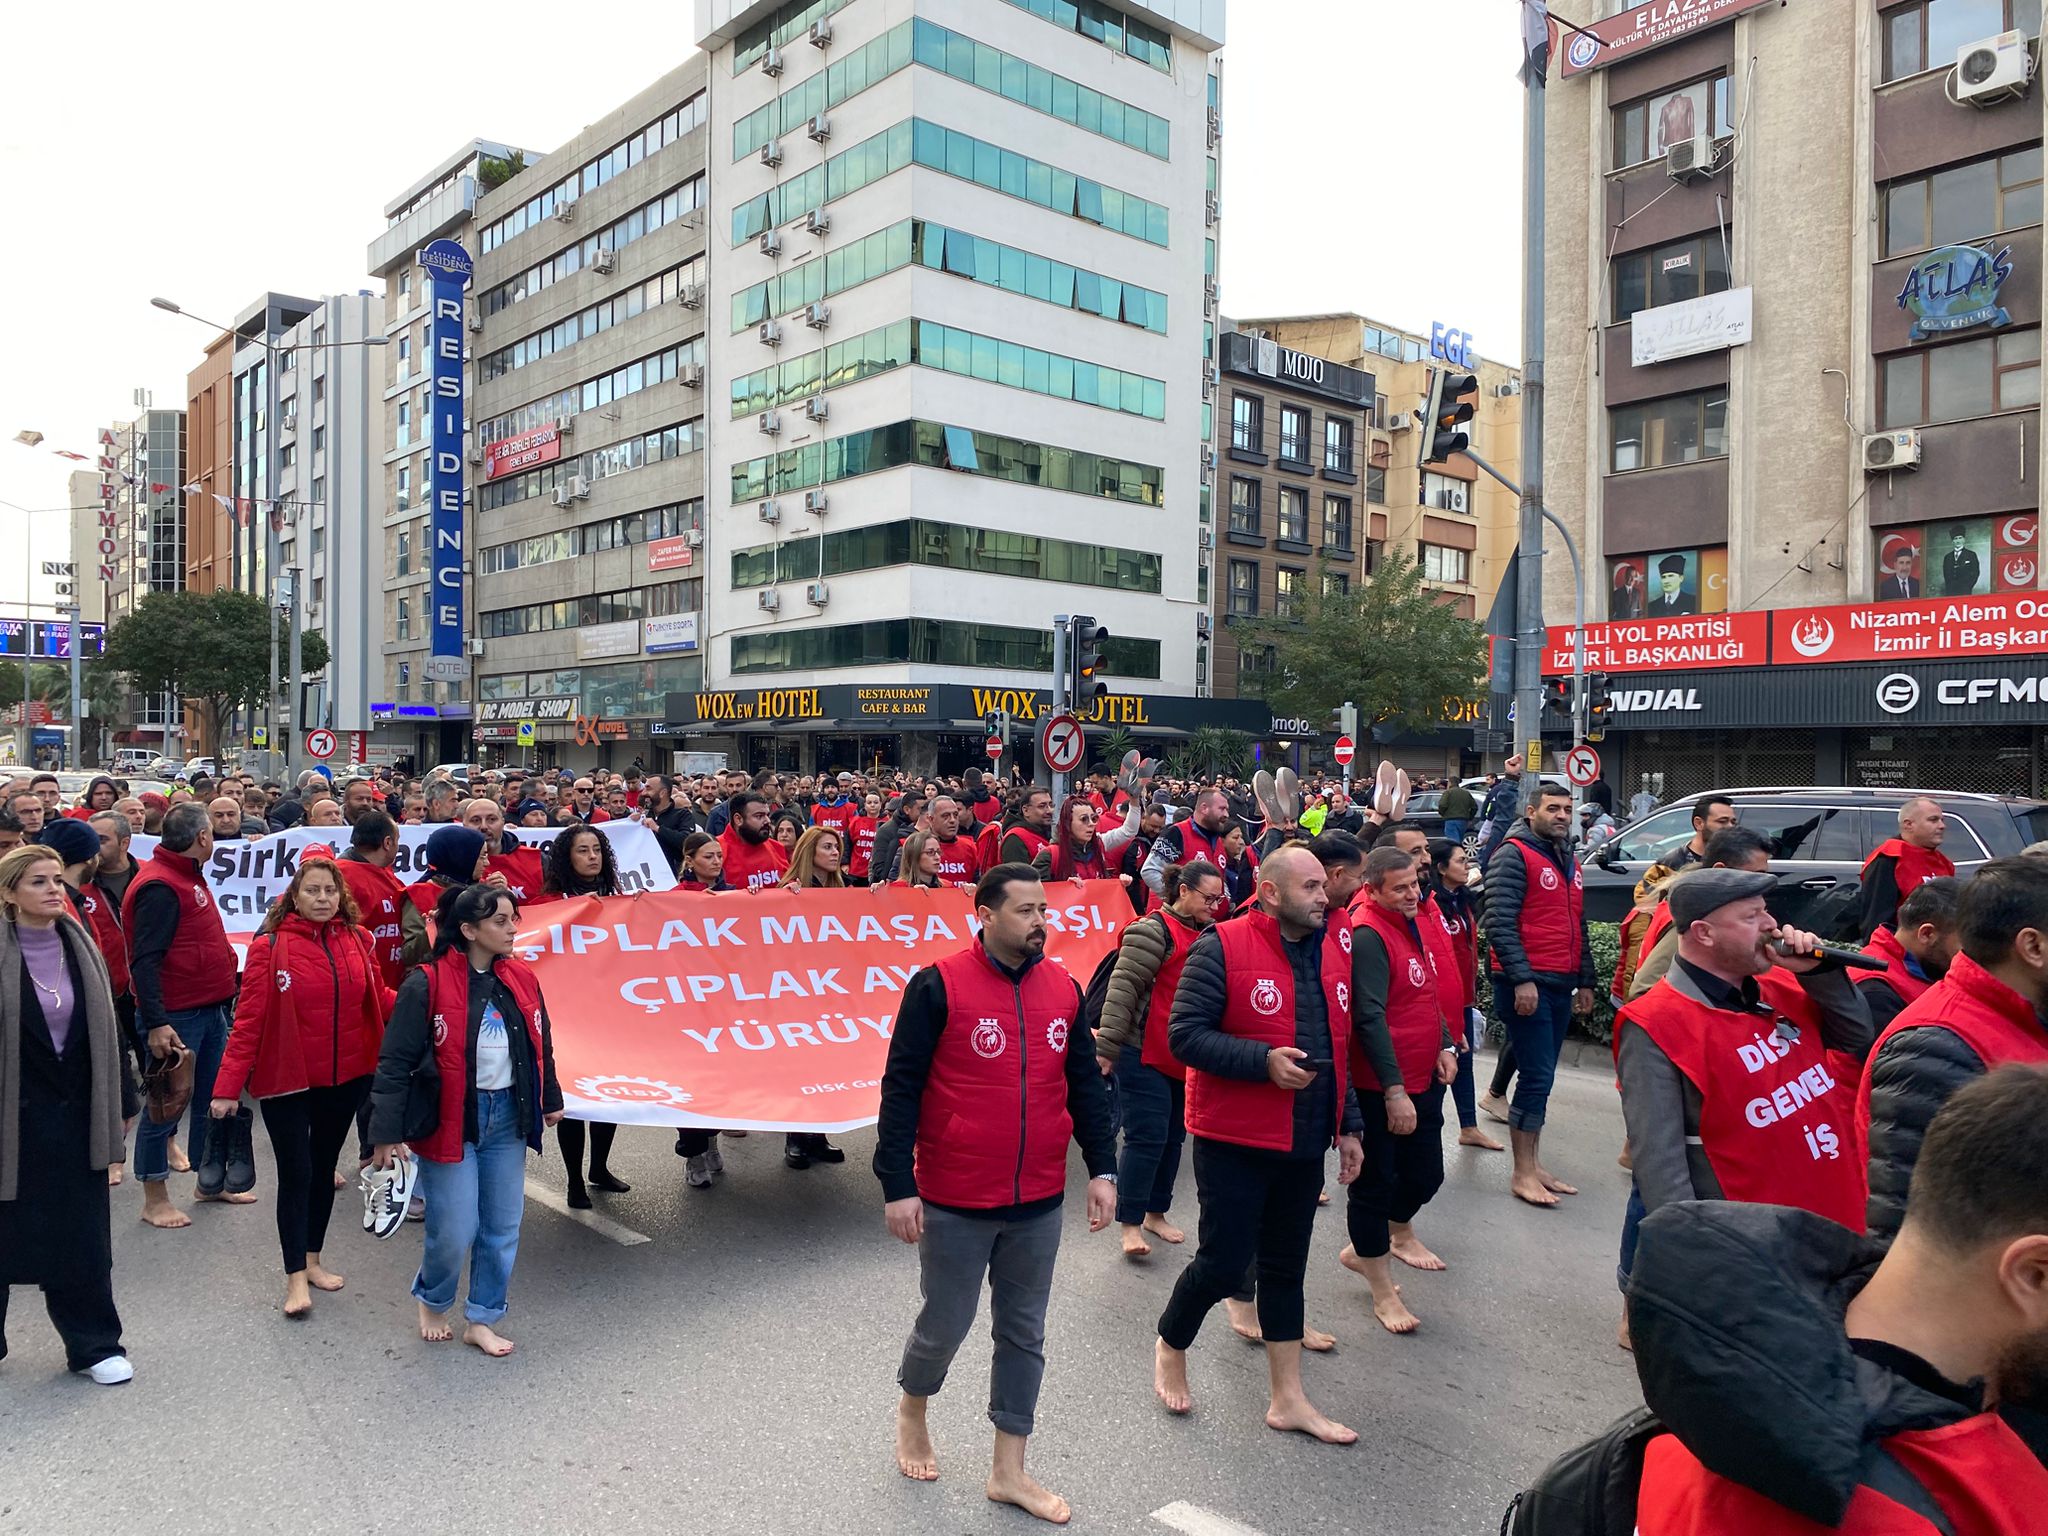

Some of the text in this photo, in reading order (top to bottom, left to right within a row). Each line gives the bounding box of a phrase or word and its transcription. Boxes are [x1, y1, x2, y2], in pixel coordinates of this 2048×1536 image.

[1610, 30, 1643, 49] KÜLTÜR
[1645, 26, 1656, 36] VE
[1658, 5, 1712, 31] DAYANIŞMA
[1635, 0, 1709, 30] ELAZ
[1651, 28, 1670, 42] 0232
[1431, 320, 1474, 369] EGE
[1283, 349, 1325, 383] MOJO
[437, 299, 461, 627] RESIDENCE
[98, 429, 117, 581] ANEMON
[1850, 610, 1936, 629] Nizam-ı
[1942, 603, 2007, 623] Alem
[1565, 617, 1732, 646] MLLİ YOL PARTİSİ
[1874, 631, 1932, 652] İzmir
[1938, 627, 1951, 649] İl
[1605, 647, 1621, 665] İL
[1625, 640, 1744, 666] BAŞKANLIĞI
[426, 661, 470, 676] HOTEL
[695, 693, 736, 719] WOX
[757, 688, 822, 718] HOTEL
[858, 688, 930, 699] RESTAURANT
[972, 688, 1036, 720] WOX
[1572, 688, 1702, 713] NDIAL
[481, 699, 572, 719] RC MODEL SHOP
[861, 703, 927, 714] CAFE & BAR
[1275, 718, 1310, 736] mojo
[822, 818, 843, 827] DİSK
[856, 839, 875, 848] GEN
[747, 869, 781, 888] DİSK
[938, 860, 966, 874] DİSK
[760, 914, 958, 949] MAAŞA
[620, 964, 921, 1014] ÇIPLAK AY
[681, 1013, 893, 1053] YÜRÜY
[1736, 1033, 1801, 1074] DİS
[800, 1079, 881, 1095] DİSK Ge
[1745, 1062, 1836, 1128] GENEL
[1803, 1122, 1840, 1161] İŞ
